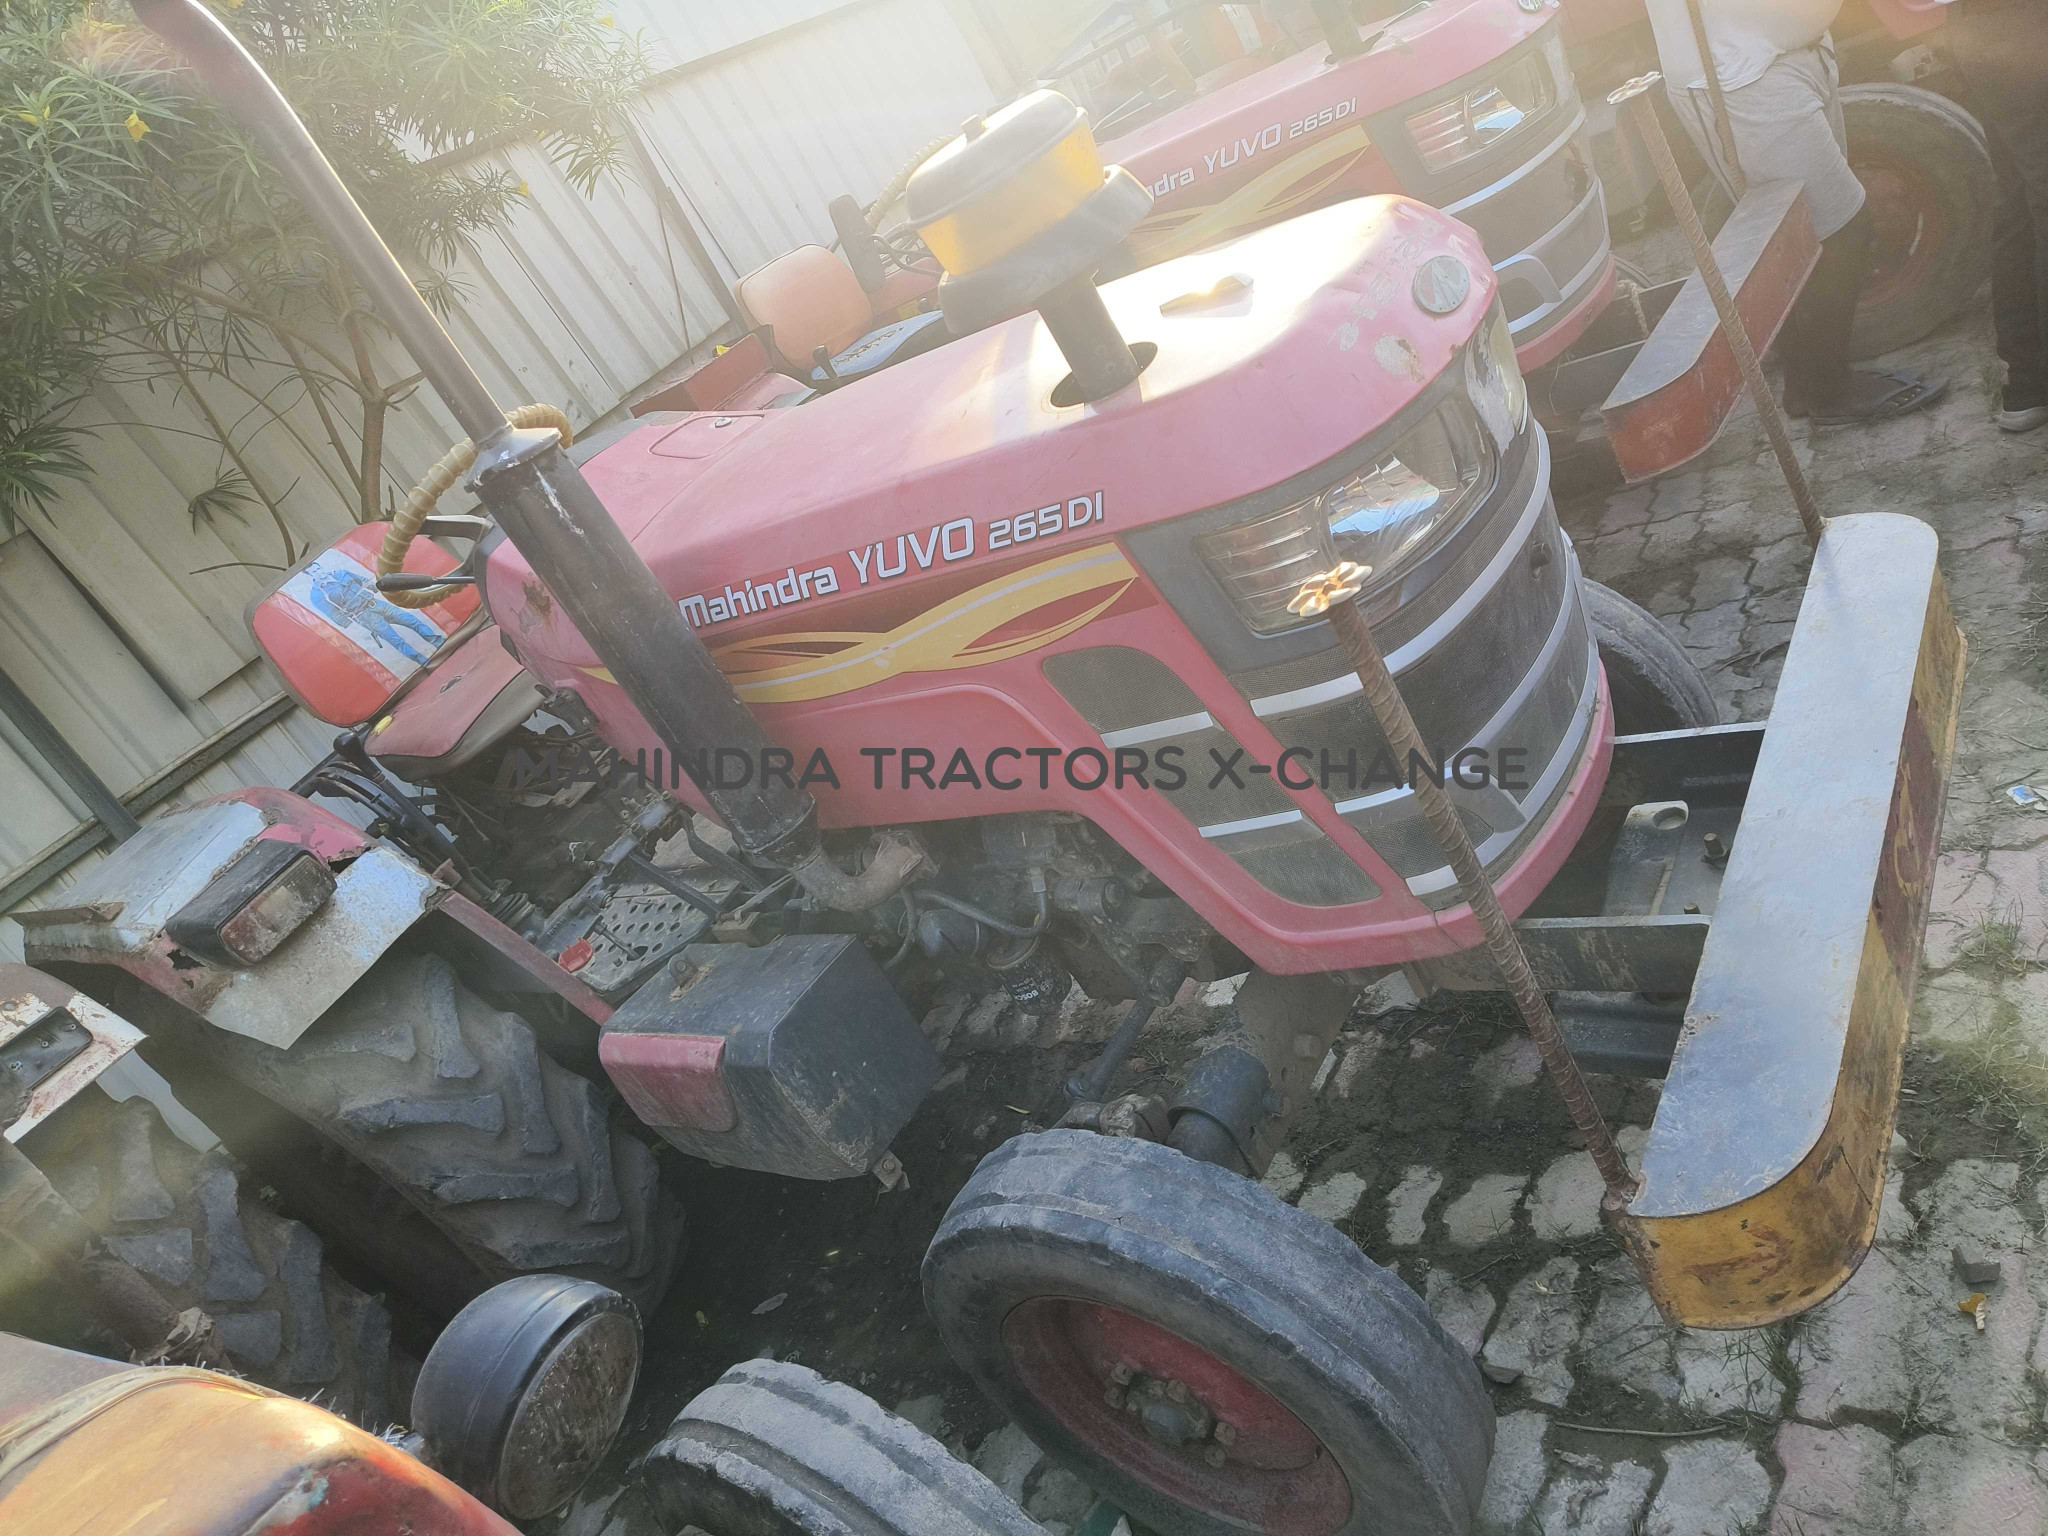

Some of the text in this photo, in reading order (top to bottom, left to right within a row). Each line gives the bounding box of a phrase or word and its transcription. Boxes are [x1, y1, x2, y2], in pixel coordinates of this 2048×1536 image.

[1203, 123, 1282, 174] YUVO
[678, 566, 839, 628] Mahindra
[848, 517, 975, 584] YUVO
